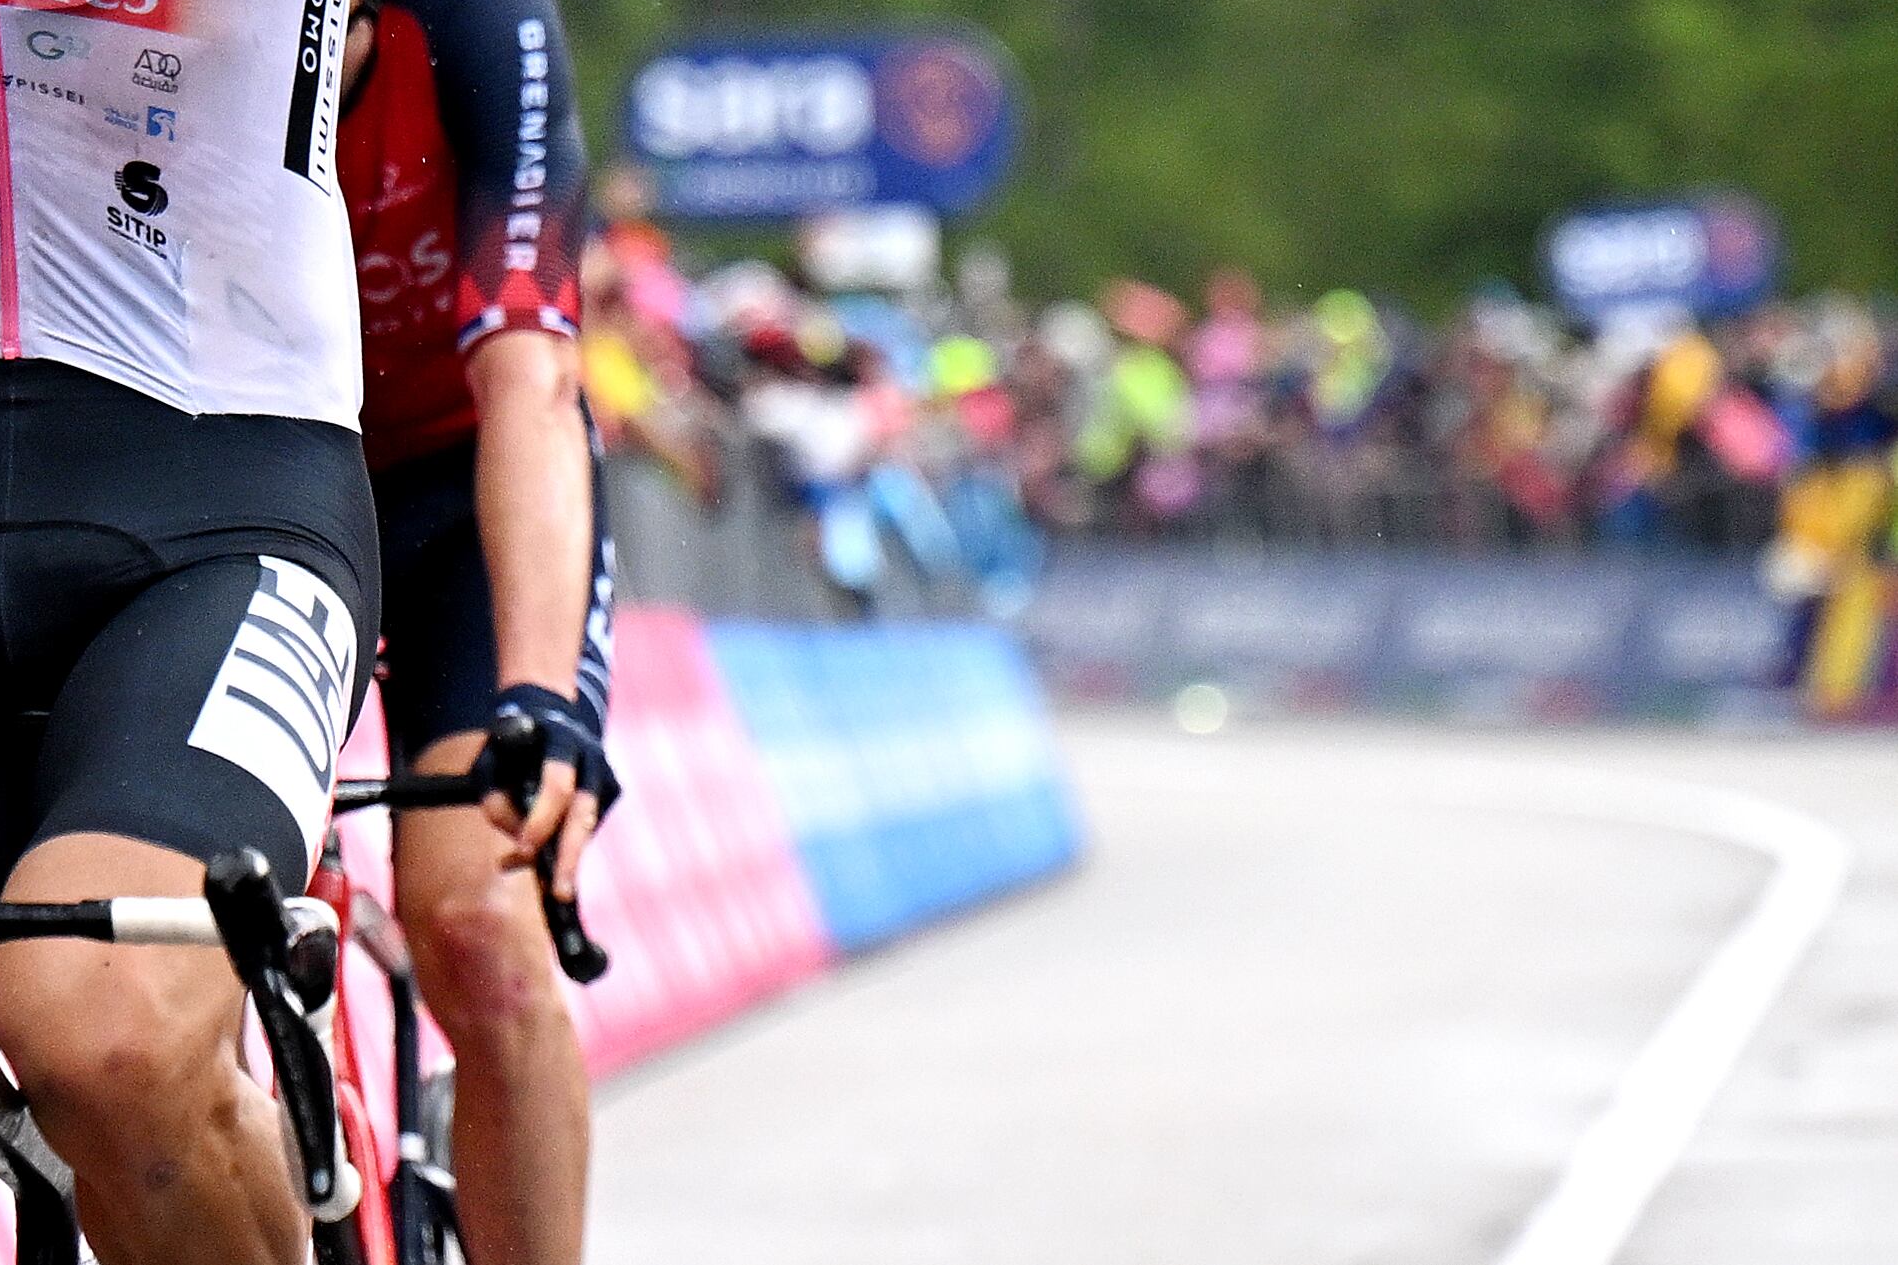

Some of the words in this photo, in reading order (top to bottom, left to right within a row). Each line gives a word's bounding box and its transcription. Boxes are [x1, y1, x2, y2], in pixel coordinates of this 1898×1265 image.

[134, 48, 182, 81] ADQ
[16, 77, 86, 105] PISSEI
[107, 206, 167, 248] SITIP
